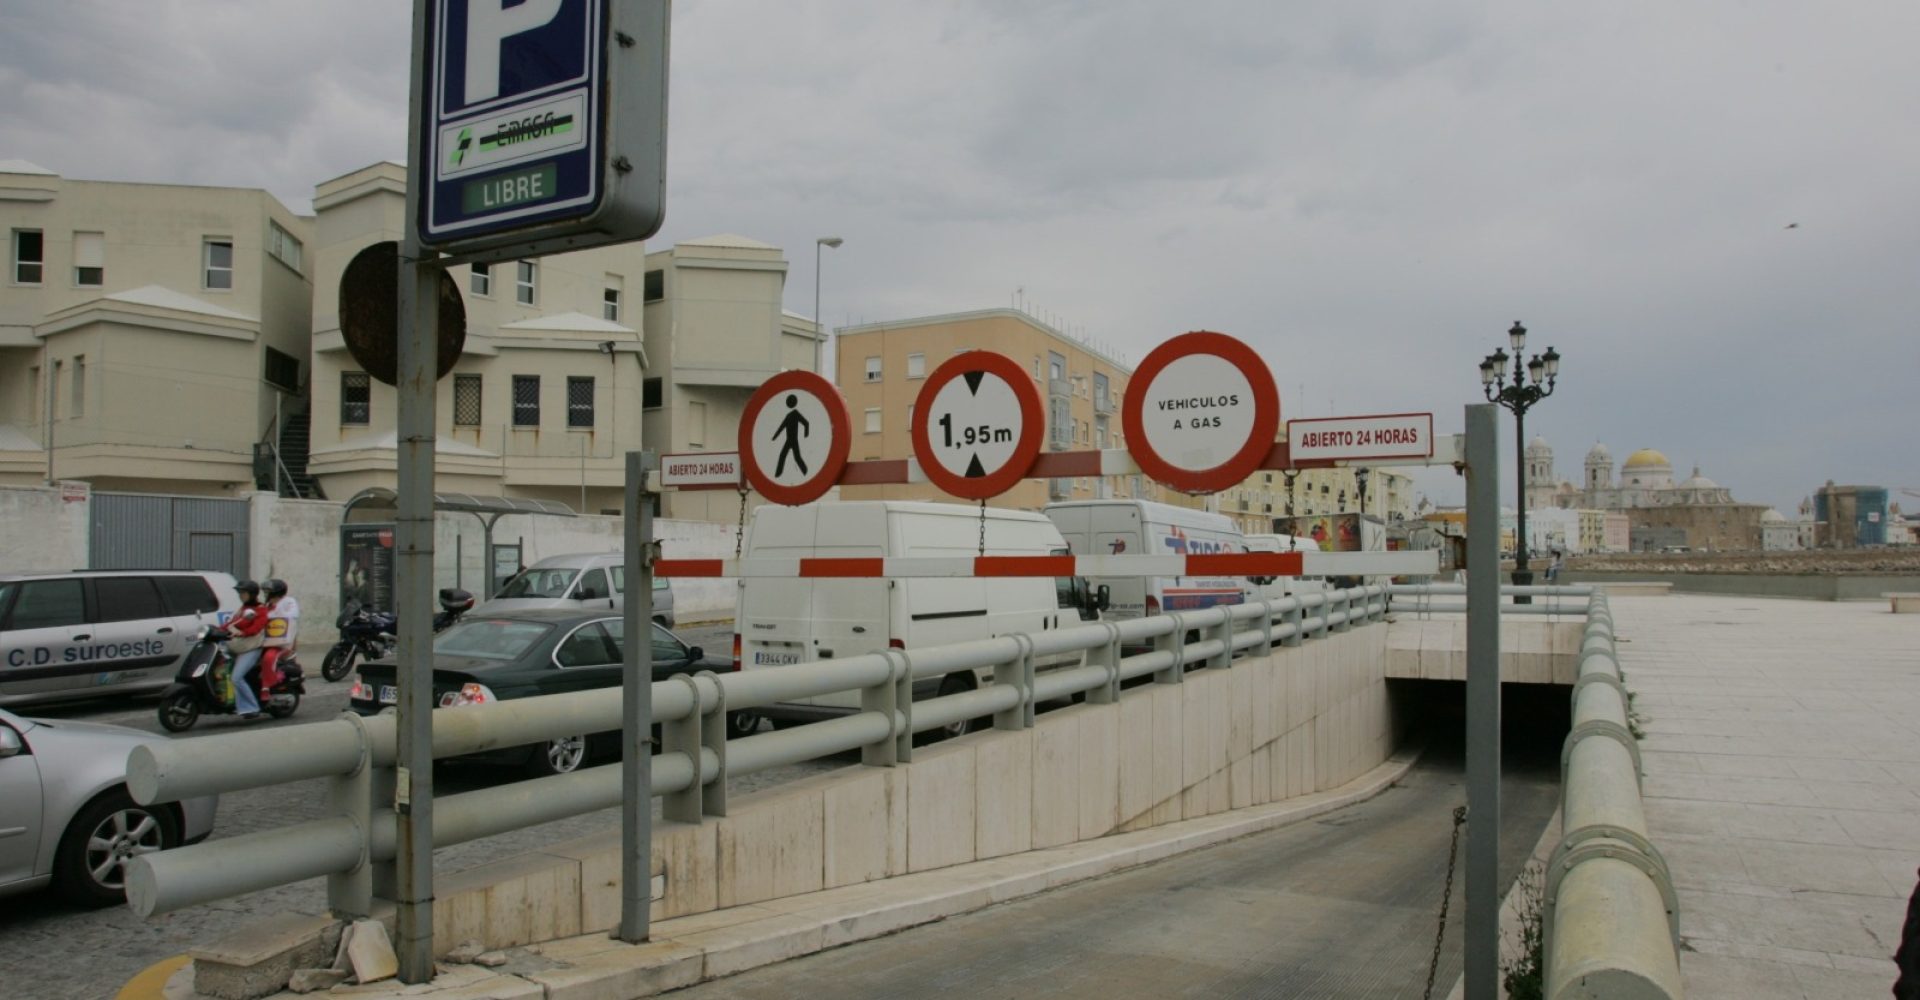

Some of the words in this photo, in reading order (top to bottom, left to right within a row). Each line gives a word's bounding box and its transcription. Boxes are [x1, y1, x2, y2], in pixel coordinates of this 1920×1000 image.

[464, 0, 564, 106] P
[483, 173, 543, 207] LIBRE
[1159, 394, 1238, 411] VEHICULOS
[1174, 419, 1182, 430] A
[1191, 416, 1221, 429] GAS
[1302, 431, 1353, 448] ABIERTO
[1356, 430, 1371, 445] 24
[1375, 428, 1417, 444] HORAS
[669, 464, 698, 476] ABIERTO
[699, 463, 708, 475] 24
[709, 462, 734, 474] HORAS
[8, 646, 57, 667] C.D.
[64, 638, 164, 662] suroeste
